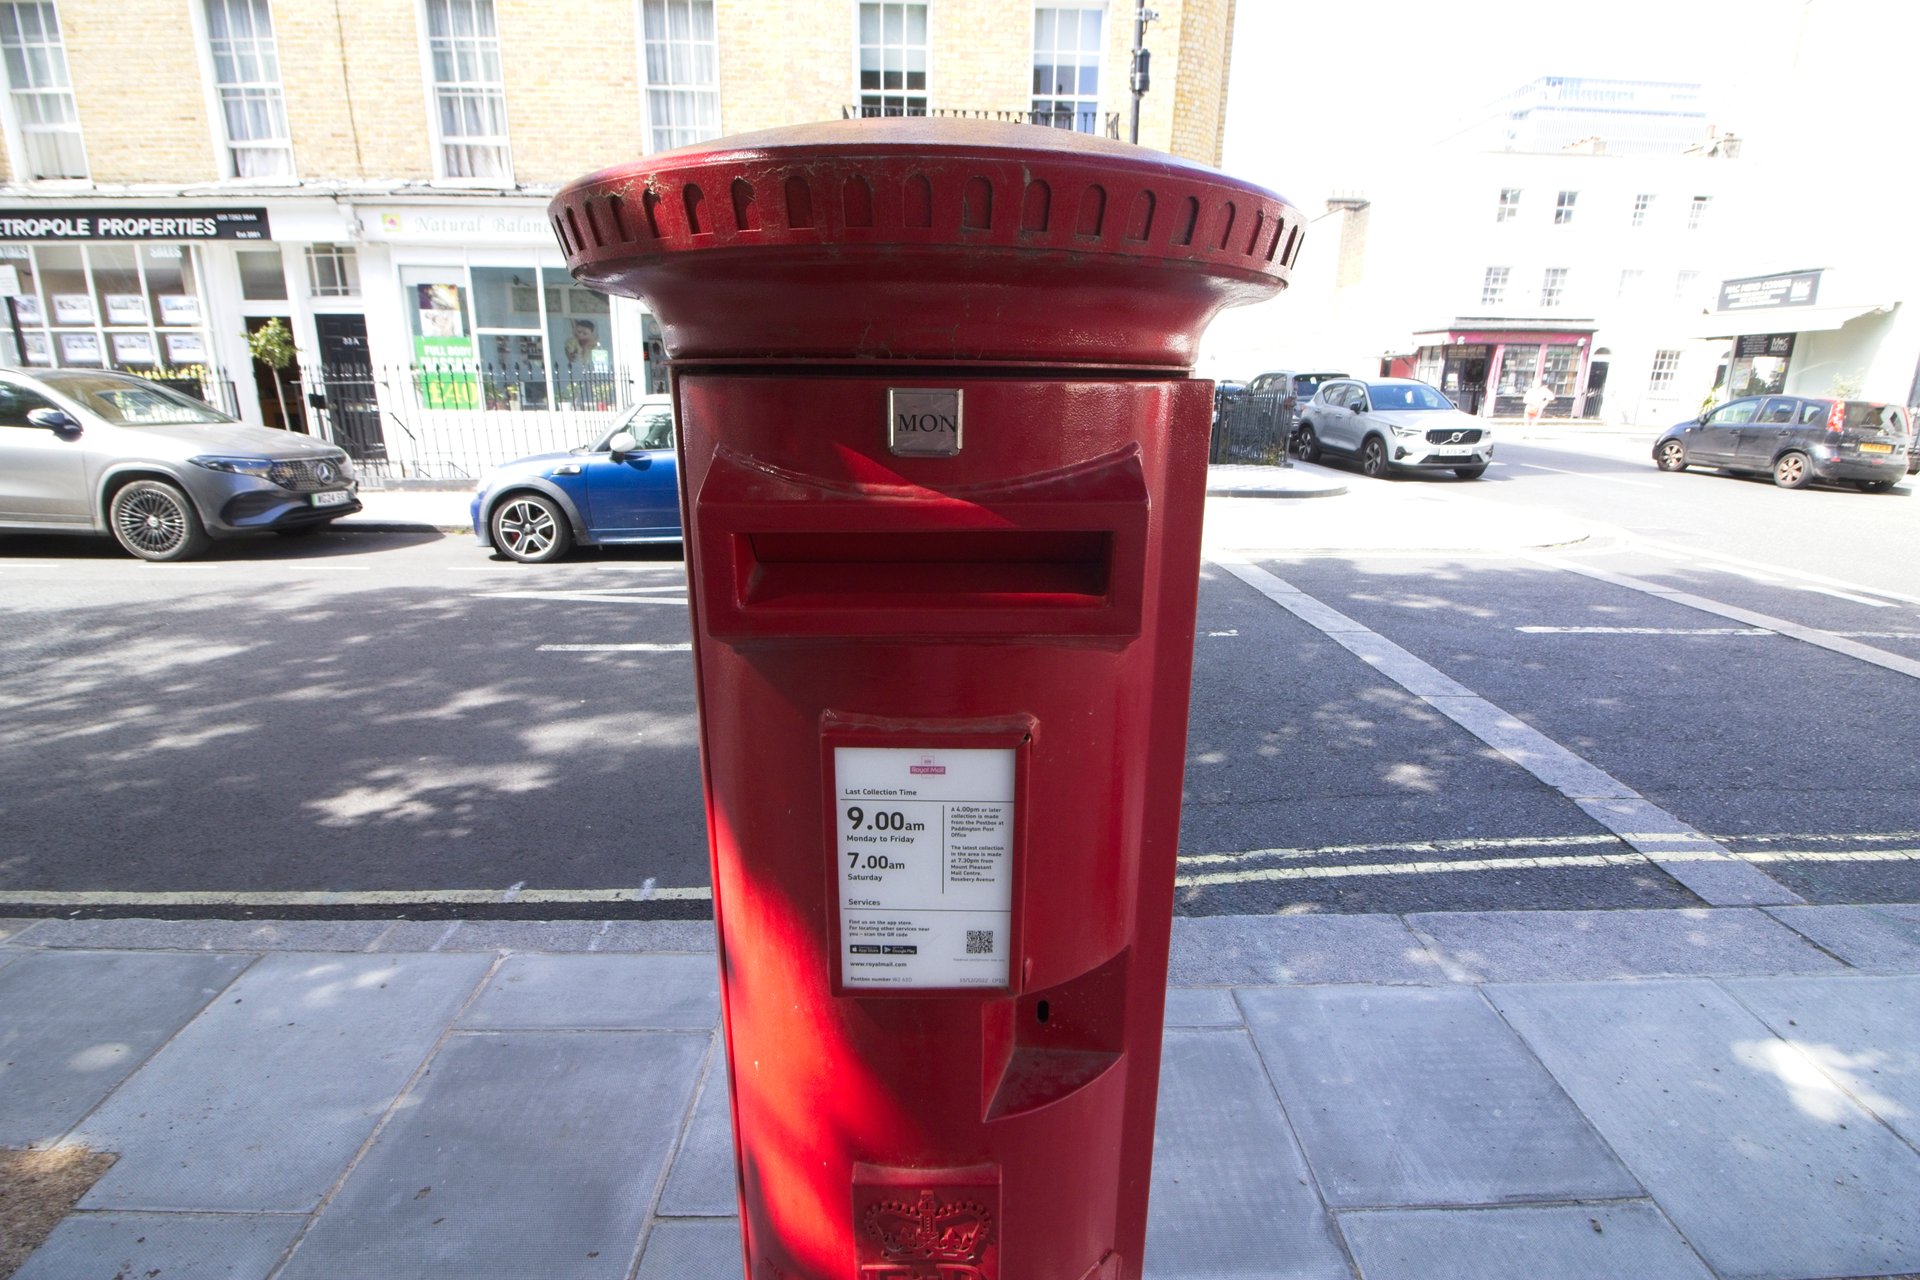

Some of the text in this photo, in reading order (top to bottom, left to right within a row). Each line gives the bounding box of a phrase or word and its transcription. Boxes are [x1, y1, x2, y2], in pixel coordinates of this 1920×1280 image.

[98, 218, 217, 236] PROPERTIES
[416, 214, 551, 233] Natural Balanc
[898, 414, 957, 432] MON
[847, 806, 925, 831] 9.00am
[846, 835, 877, 843] Monday
[890, 836, 915, 844] Friday
[847, 852, 905, 869] 7.00am
[848, 874, 883, 882] Saturday
